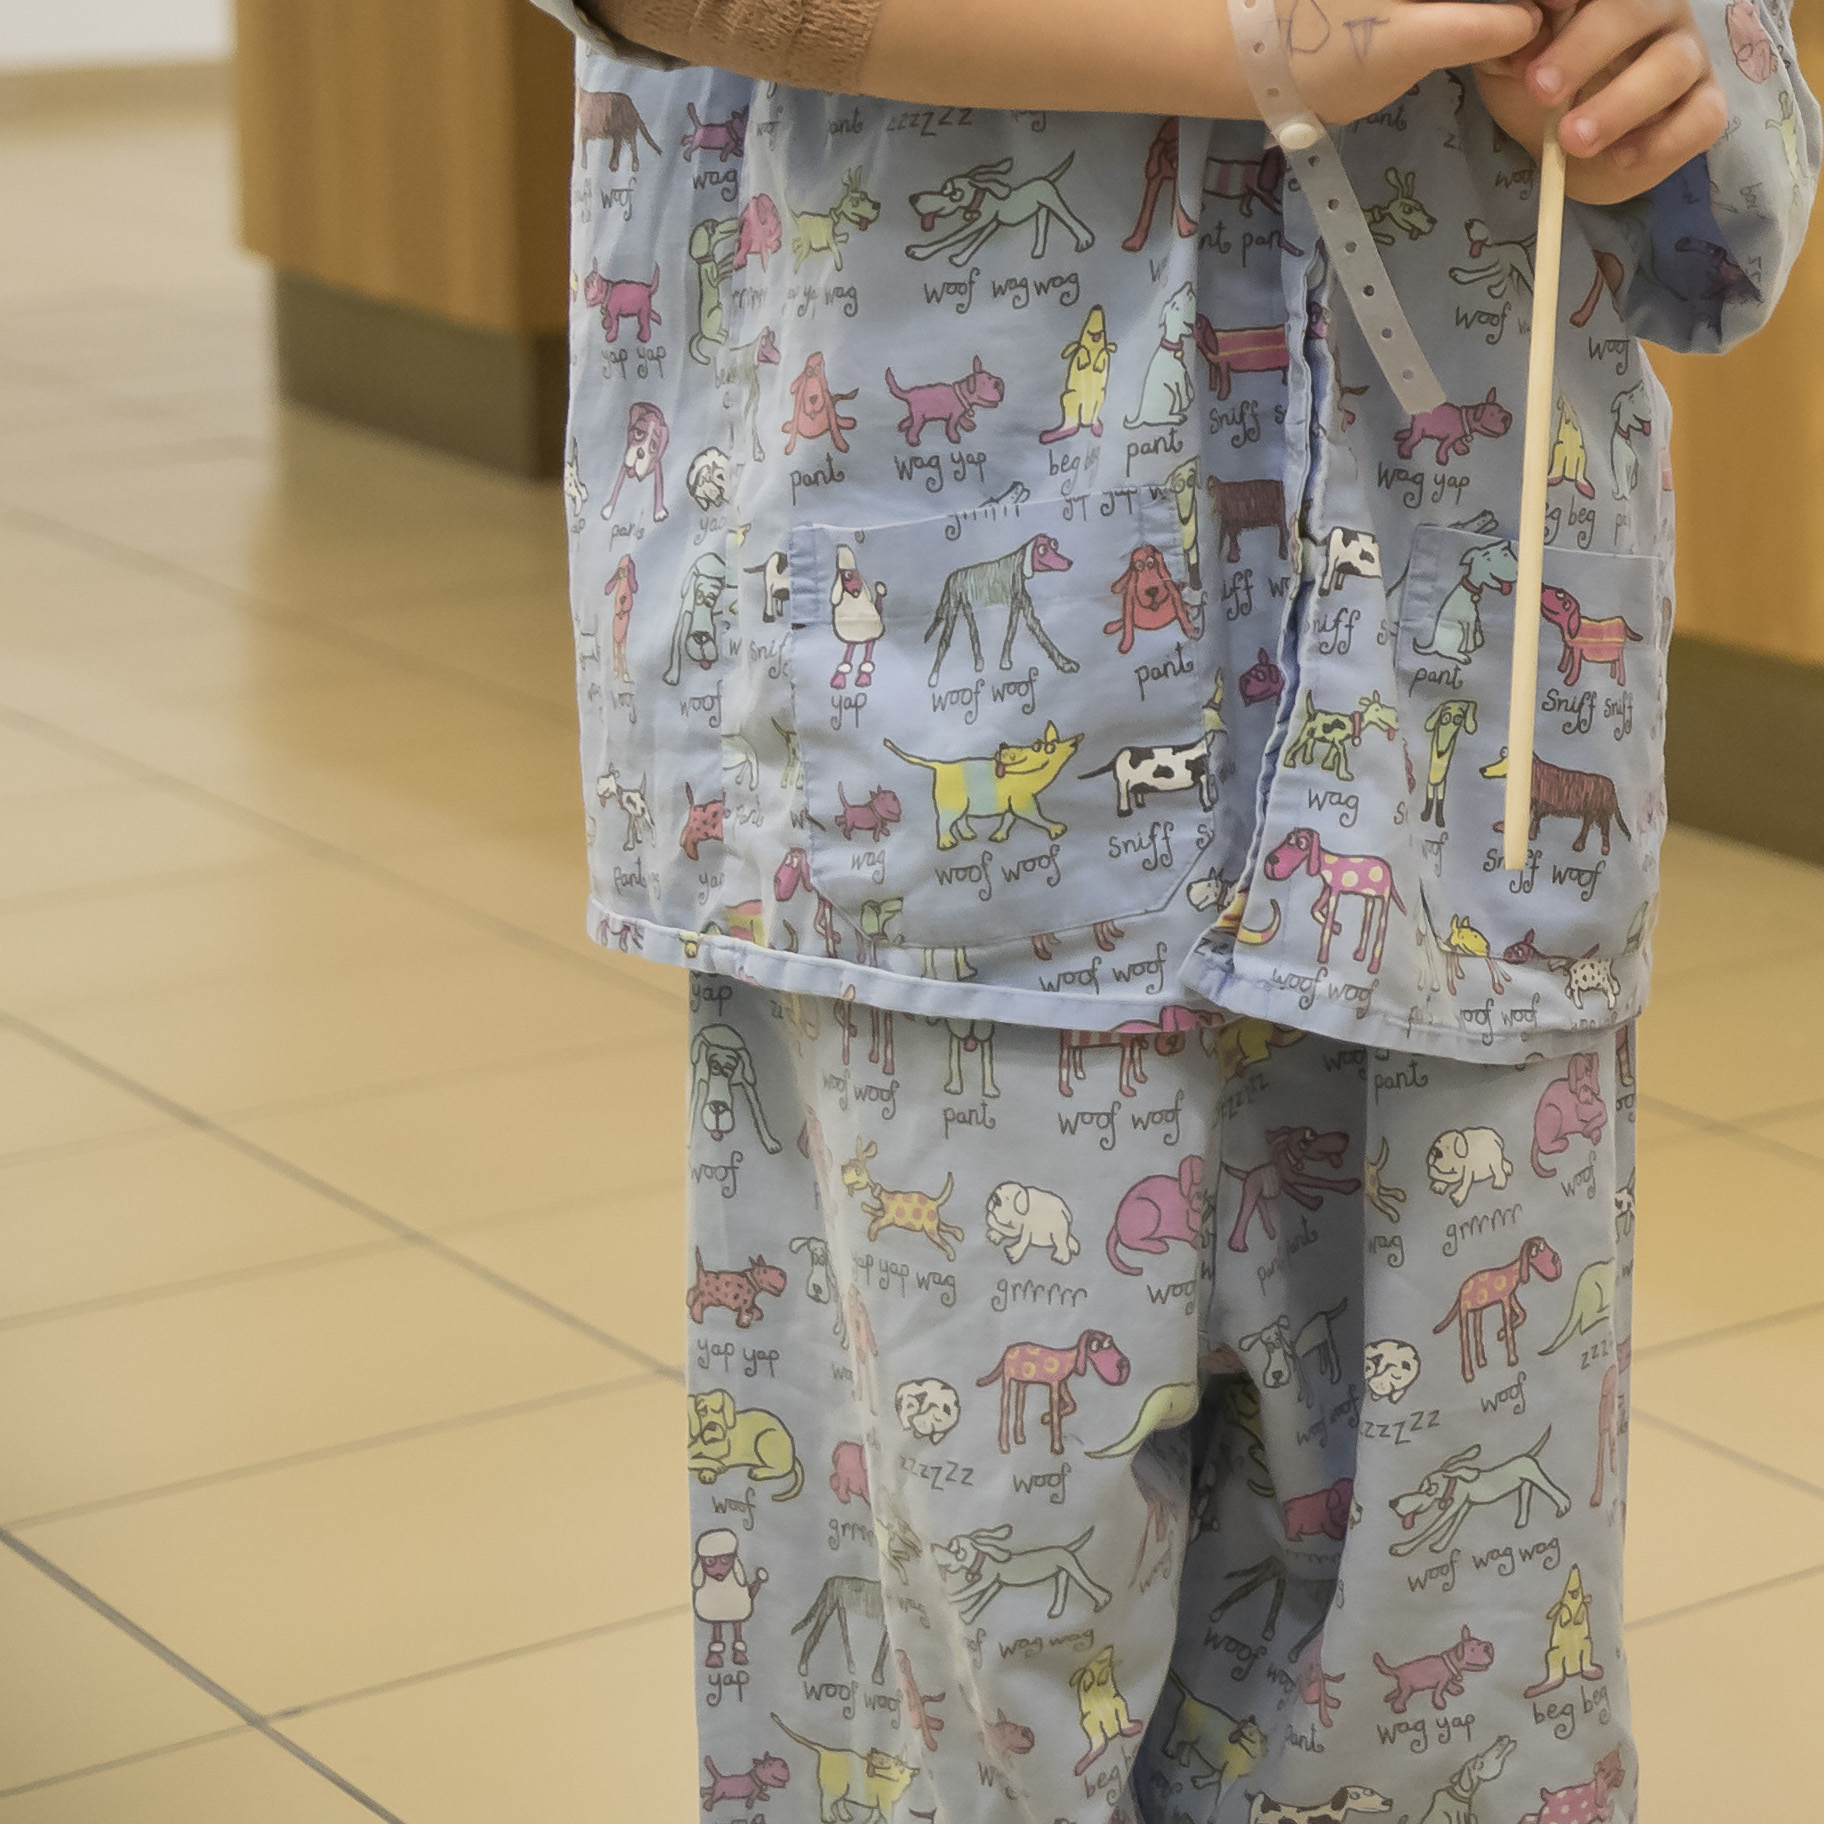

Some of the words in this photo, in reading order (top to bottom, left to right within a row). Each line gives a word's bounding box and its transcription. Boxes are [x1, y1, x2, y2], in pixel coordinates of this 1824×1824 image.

[693, 169, 739, 202] wag
[924, 269, 981, 314] woof
[992, 277, 1030, 309] wag
[1035, 273, 1081, 307] wag
[1455, 301, 1512, 345] woof
[601, 348, 628, 378] yap
[636, 346, 667, 379] yap
[894, 454, 944, 493] wag
[950, 450, 987, 482] yap
[1049, 449, 1081, 496] beg
[1126, 429, 1184, 476] pant
[790, 452, 845, 505] pant
[1377, 463, 1425, 508] wag
[1433, 473, 1471, 505] yap
[1568, 498, 1597, 549] beg
[1134, 642, 1195, 701] pant
[1409, 665, 1464, 698] pant
[830, 692, 868, 730] yap
[932, 679, 985, 725] woof
[991, 667, 1039, 714] woof
[1308, 788, 1360, 827] wag
[851, 849, 887, 885] wag
[936, 851, 993, 901] woof
[1001, 844, 1062, 888] woof
[1552, 859, 1607, 902] woof
[1112, 941, 1168, 995] woof
[1271, 966, 1329, 1010] woof
[854, 1079, 899, 1120] woof
[1374, 1058, 1429, 1106] pant
[943, 1100, 997, 1139] pant
[1058, 1101, 1122, 1151] woof
[1132, 1088, 1185, 1146] woof
[1560, 1150, 1597, 1199] woof
[878, 1257, 910, 1298] yap
[916, 1271, 957, 1307] wag
[697, 1339, 735, 1373] yap
[743, 1347, 780, 1378] yap
[1480, 1371, 1527, 1415] woof
[1012, 1461, 1072, 1505] woof
[711, 1487, 756, 1531] woof
[1407, 1549, 1461, 1592] woof
[1471, 1543, 1515, 1577] wag
[1519, 1537, 1561, 1571] wag
[1204, 1627, 1269, 1681] woof
[706, 1671, 749, 1707] yap
[804, 1680, 859, 1720] woof
[1378, 1718, 1428, 1753] wag
[1436, 1713, 1476, 1742] yap
[1533, 1701, 1575, 1739] beg
[1581, 1684, 1611, 1726] beg
